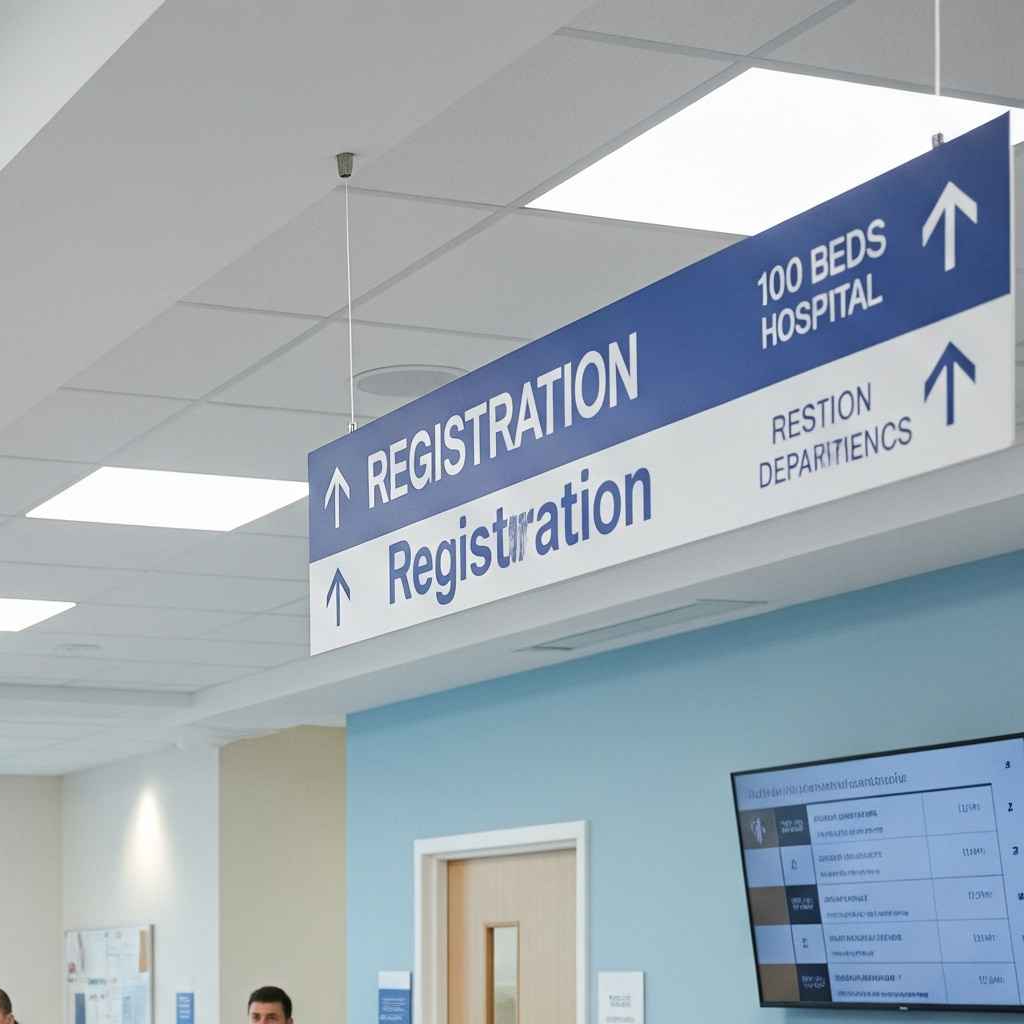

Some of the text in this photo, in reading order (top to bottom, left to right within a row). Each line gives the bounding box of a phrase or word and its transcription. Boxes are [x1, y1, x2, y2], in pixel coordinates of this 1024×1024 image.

[757, 218, 887, 306] 100 BEDS
[761, 273, 883, 350] HOSPITAL
[368, 332, 638, 509] REGISTRATION
[772, 382, 871, 445] RESTION
